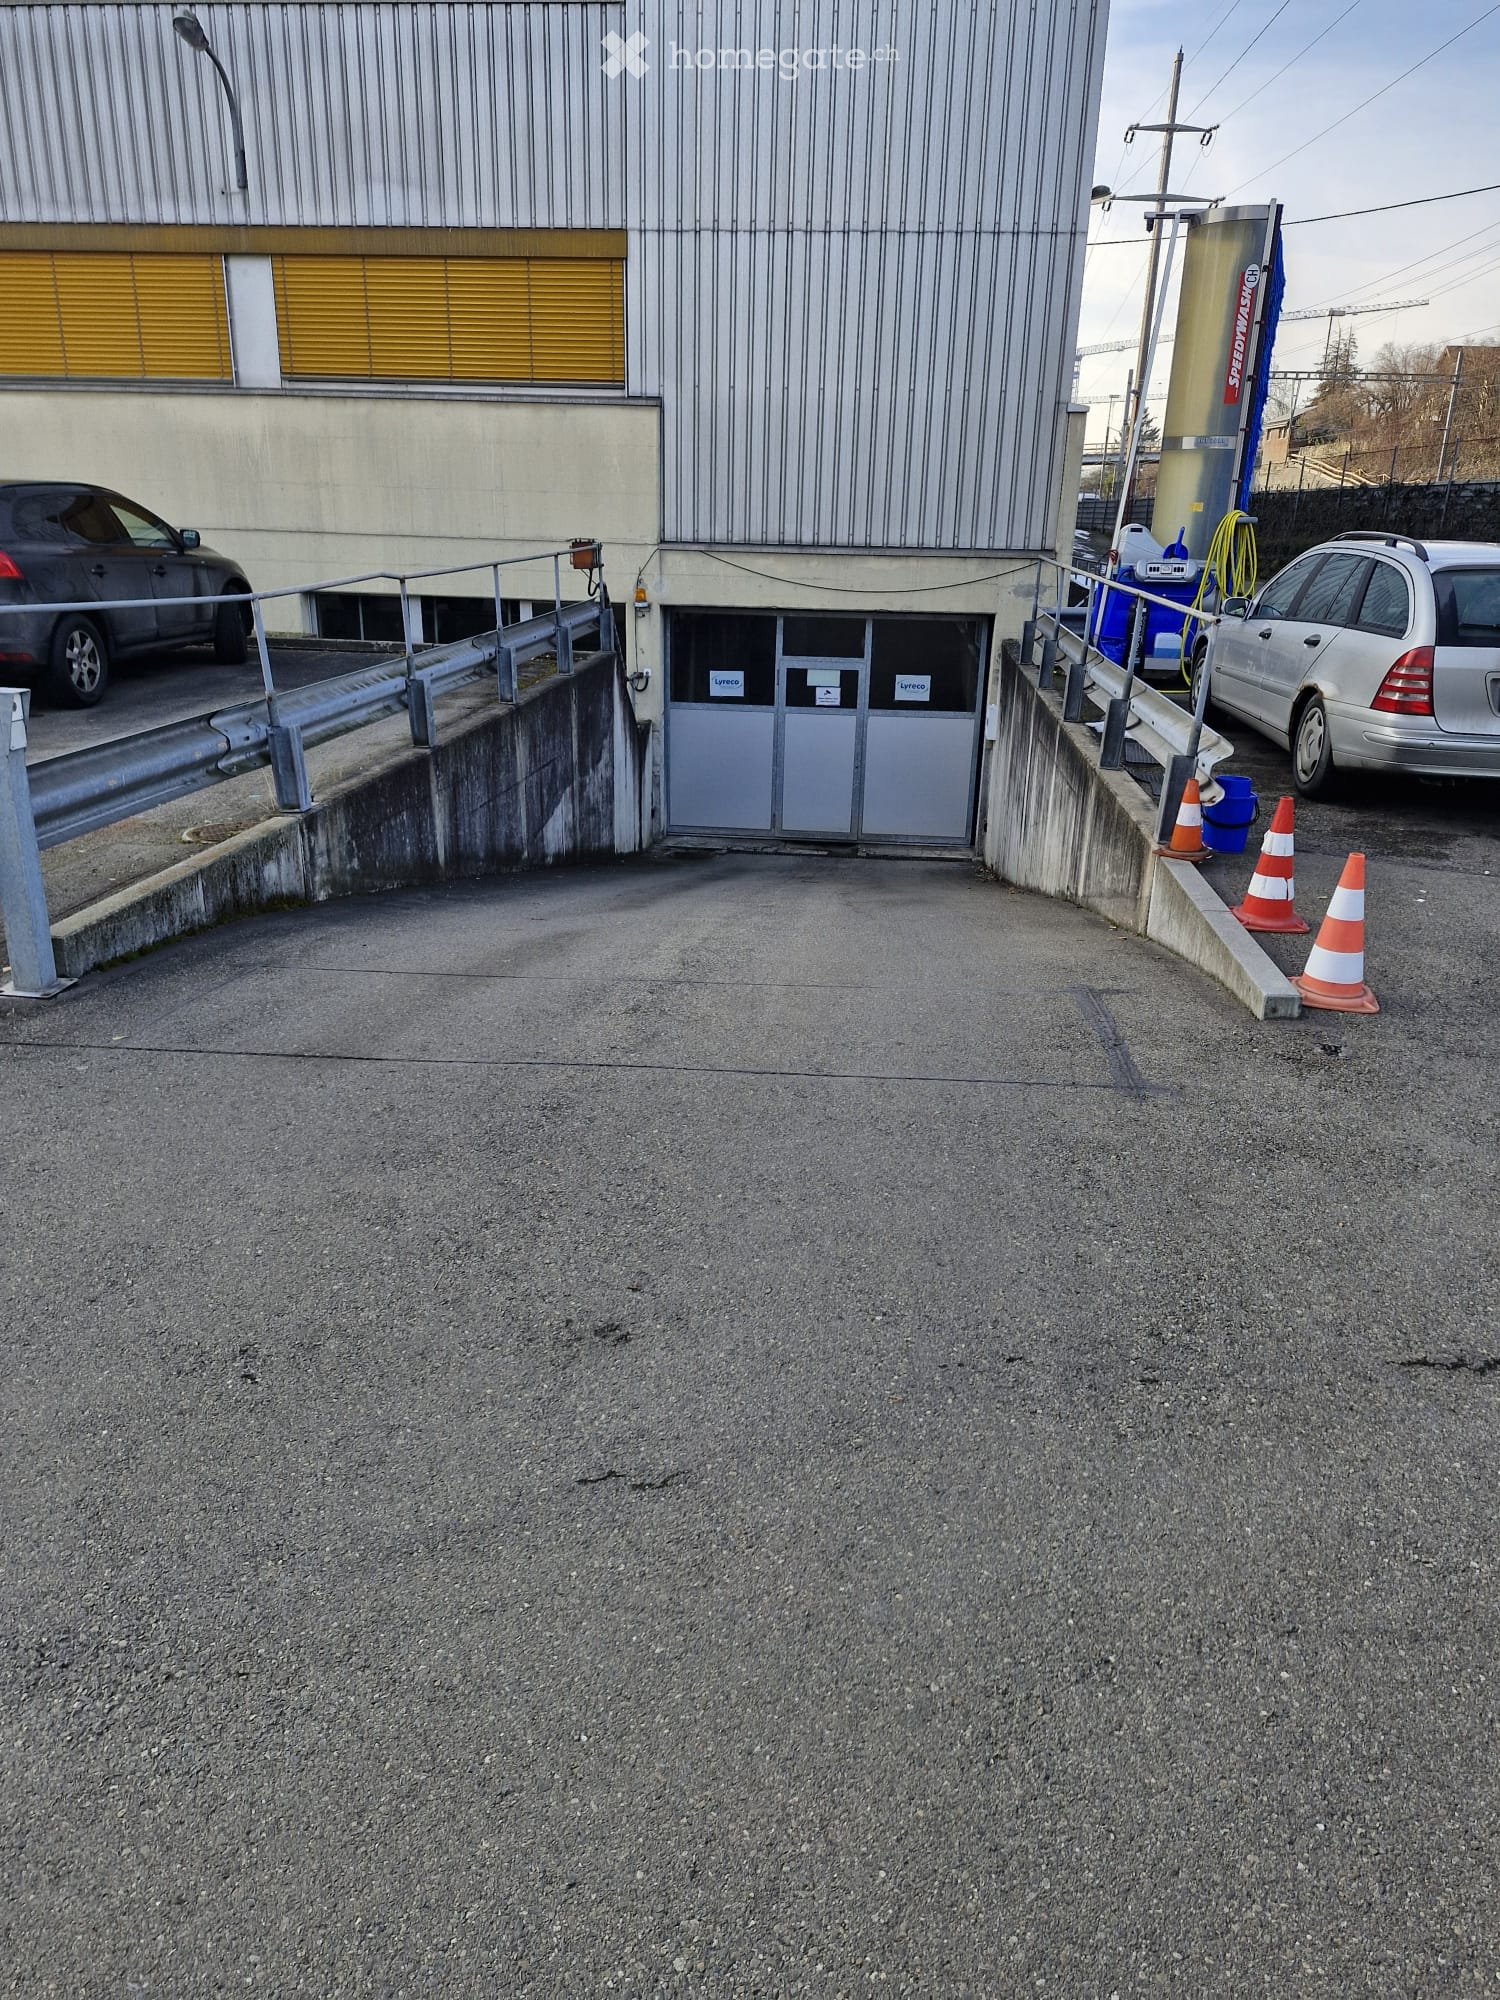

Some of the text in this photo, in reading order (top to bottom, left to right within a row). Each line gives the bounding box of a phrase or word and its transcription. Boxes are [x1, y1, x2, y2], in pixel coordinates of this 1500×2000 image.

[1228, 269, 1258, 388] SPEEDYWASH CH
[714, 678, 740, 686] Lyreco
[900, 682, 926, 691] Lyreco
